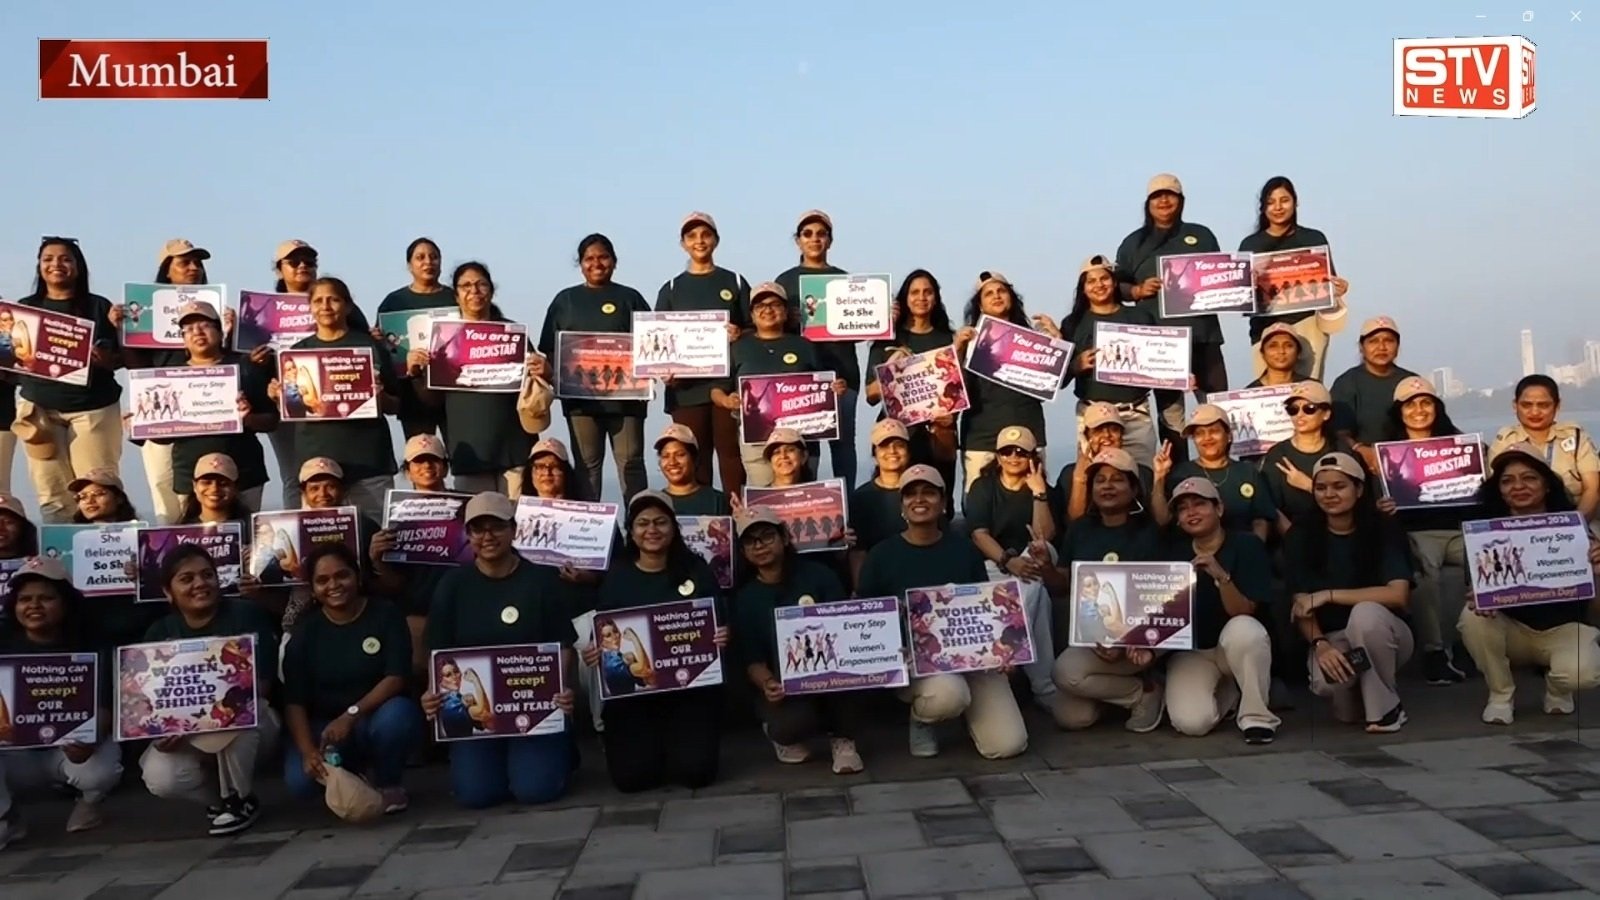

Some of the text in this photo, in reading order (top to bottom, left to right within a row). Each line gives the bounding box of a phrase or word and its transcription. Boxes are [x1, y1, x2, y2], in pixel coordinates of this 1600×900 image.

[1194, 261, 1215, 270] You
[1217, 261, 1235, 269] are
[1200, 270, 1243, 286] ROCKSTAR
[848, 284, 866, 292] She
[276, 301, 296, 311] You
[843, 309, 873, 317] So She
[44, 318, 73, 332] Nothing
[837, 321, 880, 330] Achieved
[48, 335, 78, 348] except
[466, 330, 520, 342] You are a
[470, 343, 517, 358] ROCKSTAR
[1012, 334, 1062, 357] You are a
[321, 356, 350, 365] Nothing
[1011, 350, 1058, 367] ROCKSTAR
[329, 373, 360, 381] except
[210, 381, 226, 389] Step
[775, 382, 829, 393] You are a
[781, 393, 826, 411] ROCKSTAR
[1414, 446, 1473, 458] You are a
[1424, 455, 1471, 477] ROCKSTAR
[303, 517, 334, 525] Nothing
[101, 534, 121, 543] She
[175, 535, 199, 545] You
[201, 535, 222, 543] are
[311, 533, 344, 542] except
[1530, 532, 1575, 544] Every Step
[403, 544, 448, 557] You are
[1547, 545, 1559, 553] for
[93, 560, 124, 570] So Sh
[1537, 558, 1574, 567] Women's
[1131, 573, 1184, 582] Nothing can
[1527, 568, 1587, 581] Empowerment
[815, 604, 860, 615] Walkathon
[1143, 606, 1164, 614] OUR
[653, 609, 708, 623] Nothing can
[947, 616, 984, 627] RISE,
[1127, 617, 1185, 626] OWN FEARS
[658, 619, 705, 631] weaken us
[843, 619, 886, 632] Every Step
[940, 624, 994, 637] WORLD
[664, 631, 701, 642] except
[860, 632, 871, 641] for
[942, 634, 994, 648] SHINES
[671, 645, 691, 655] OUR
[849, 643, 885, 653] Women's
[497, 655, 553, 665] Nothing can
[655, 653, 714, 669] OWN FEARS
[839, 654, 898, 667] Empowerment
[22, 665, 88, 675] Nothing can
[152, 663, 224, 676] WOMEN,
[500, 665, 551, 674] weaken us
[26, 675, 68, 684] weaken
[164, 673, 206, 687] RISE,
[506, 677, 545, 687] except
[800, 673, 887, 690] Happy Women's Day!
[31, 686, 77, 697] except
[154, 684, 216, 699] WORLD
[512, 690, 534, 700] OUR
[37, 701, 63, 709] OUR
[154, 695, 216, 709] SHINES
[495, 702, 556, 713] OWN FEARS
[16, 712, 88, 724] OWN FEARS
